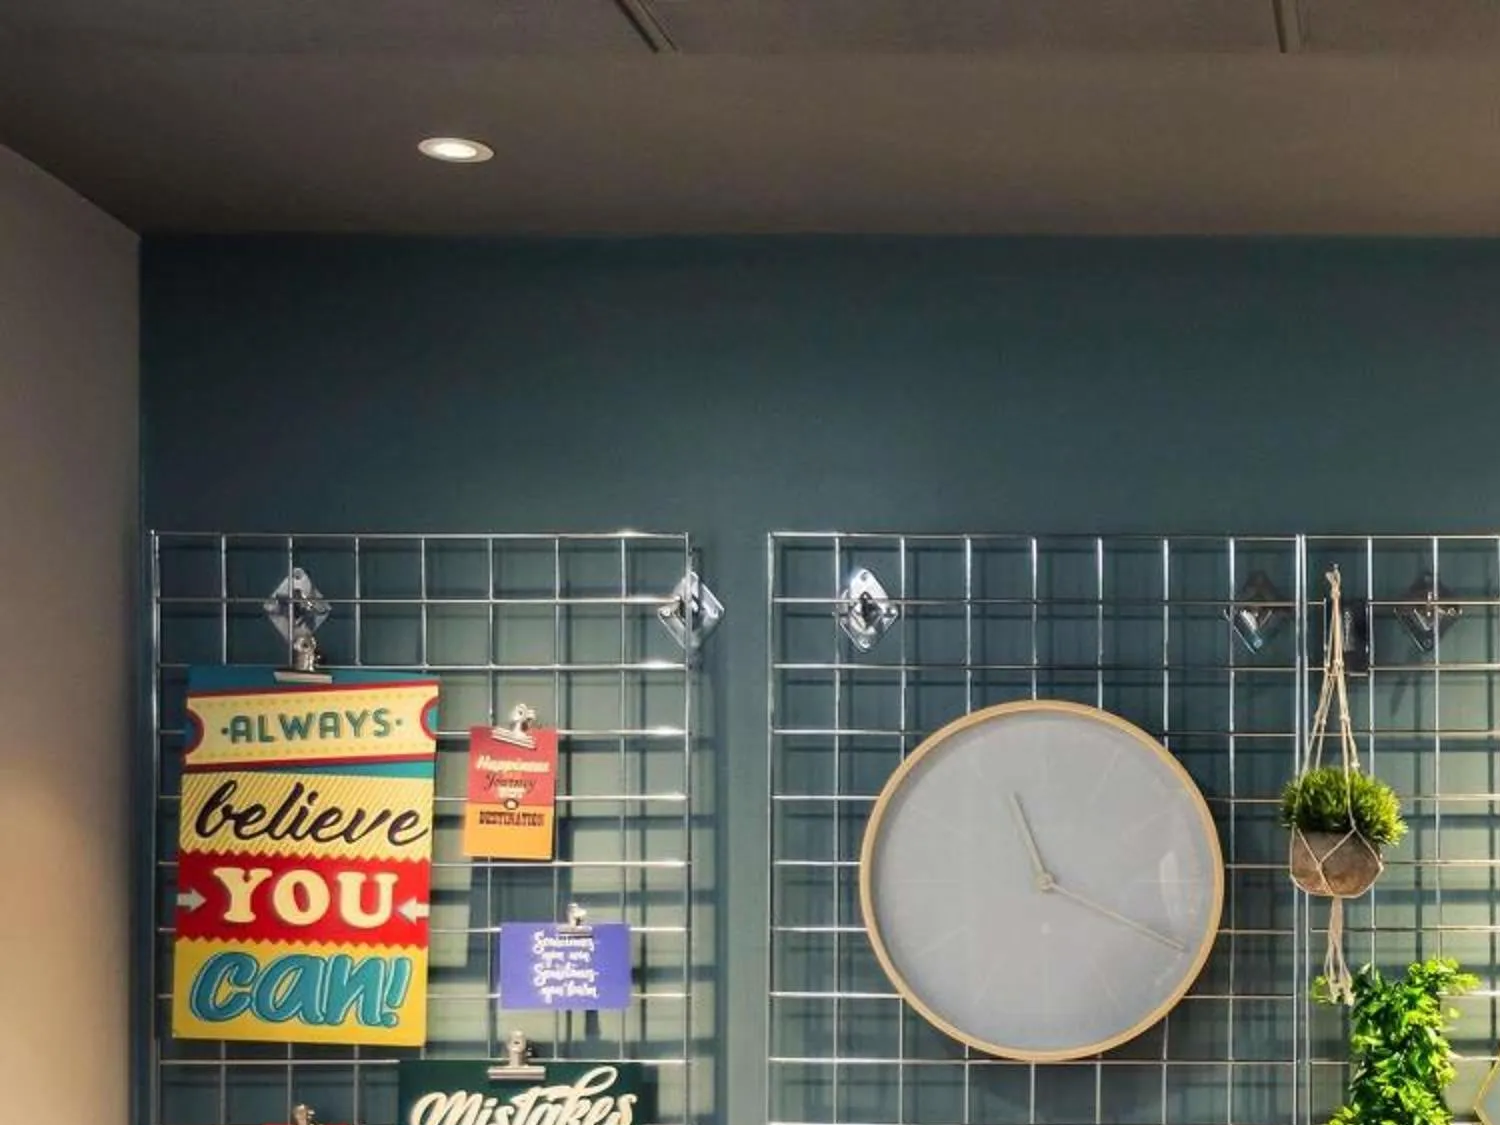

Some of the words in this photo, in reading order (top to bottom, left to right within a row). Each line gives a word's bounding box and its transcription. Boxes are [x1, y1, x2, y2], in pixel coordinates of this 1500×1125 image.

[230, 708, 391, 745] ALWAYS
[195, 779, 431, 847] believe
[213, 866, 400, 929] YOU
[189, 952, 413, 1028] can!
